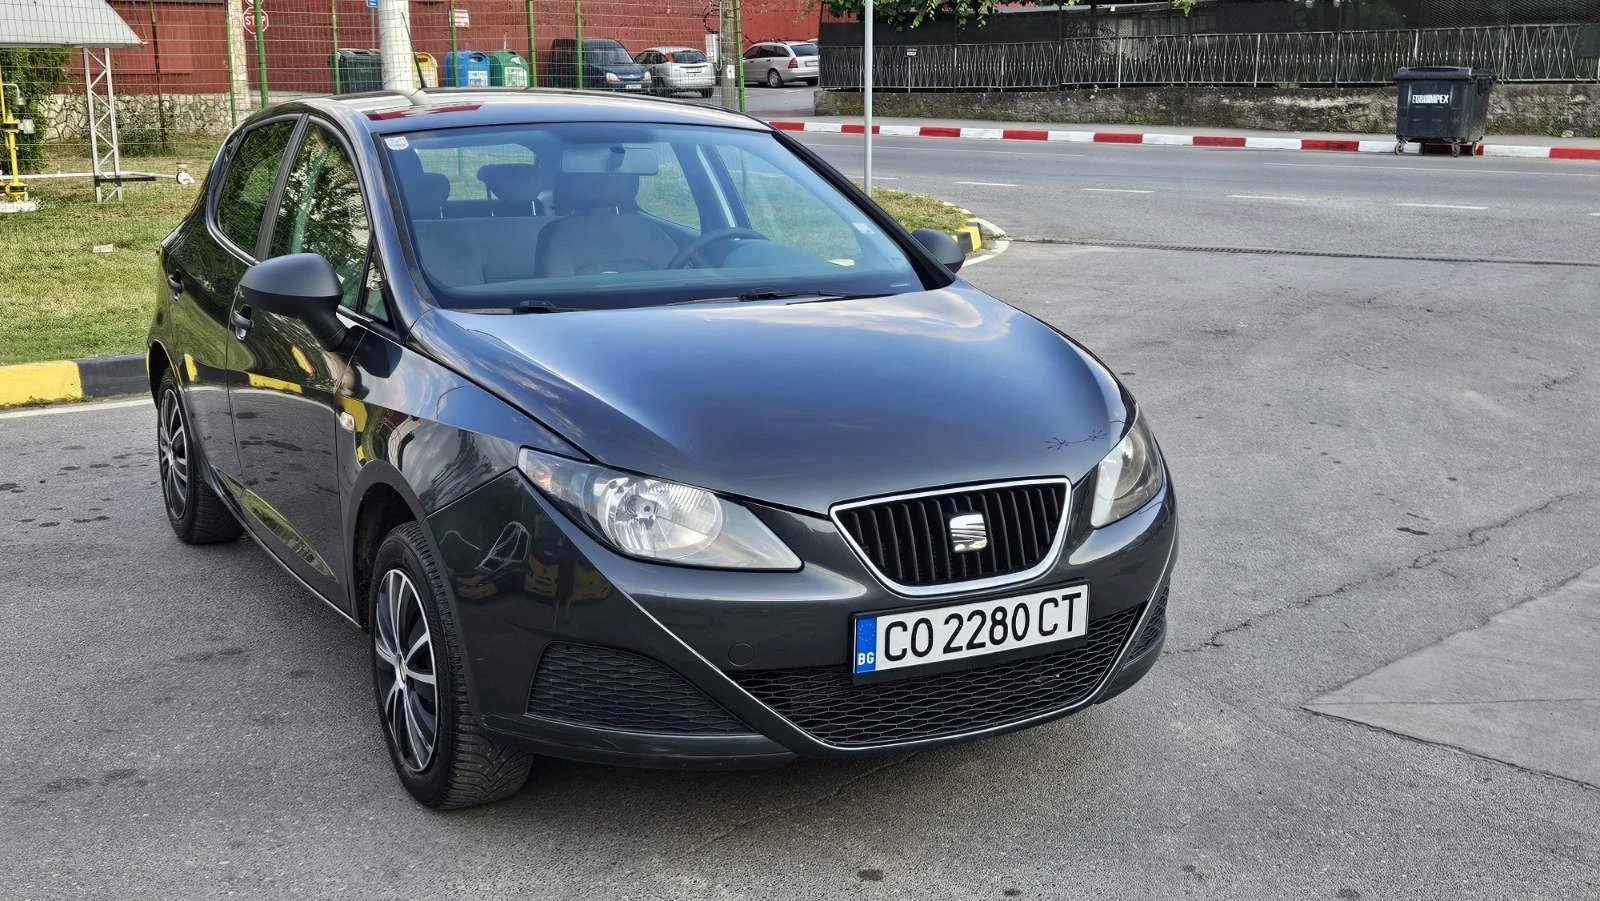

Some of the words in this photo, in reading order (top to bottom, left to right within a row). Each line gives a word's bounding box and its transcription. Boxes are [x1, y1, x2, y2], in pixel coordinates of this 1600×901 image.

[245, 15, 266, 25] STP
[884, 617, 934, 662] CO
[942, 602, 1030, 654] 2280
[1038, 592, 1082, 637] CT
[857, 651, 874, 666] BG
